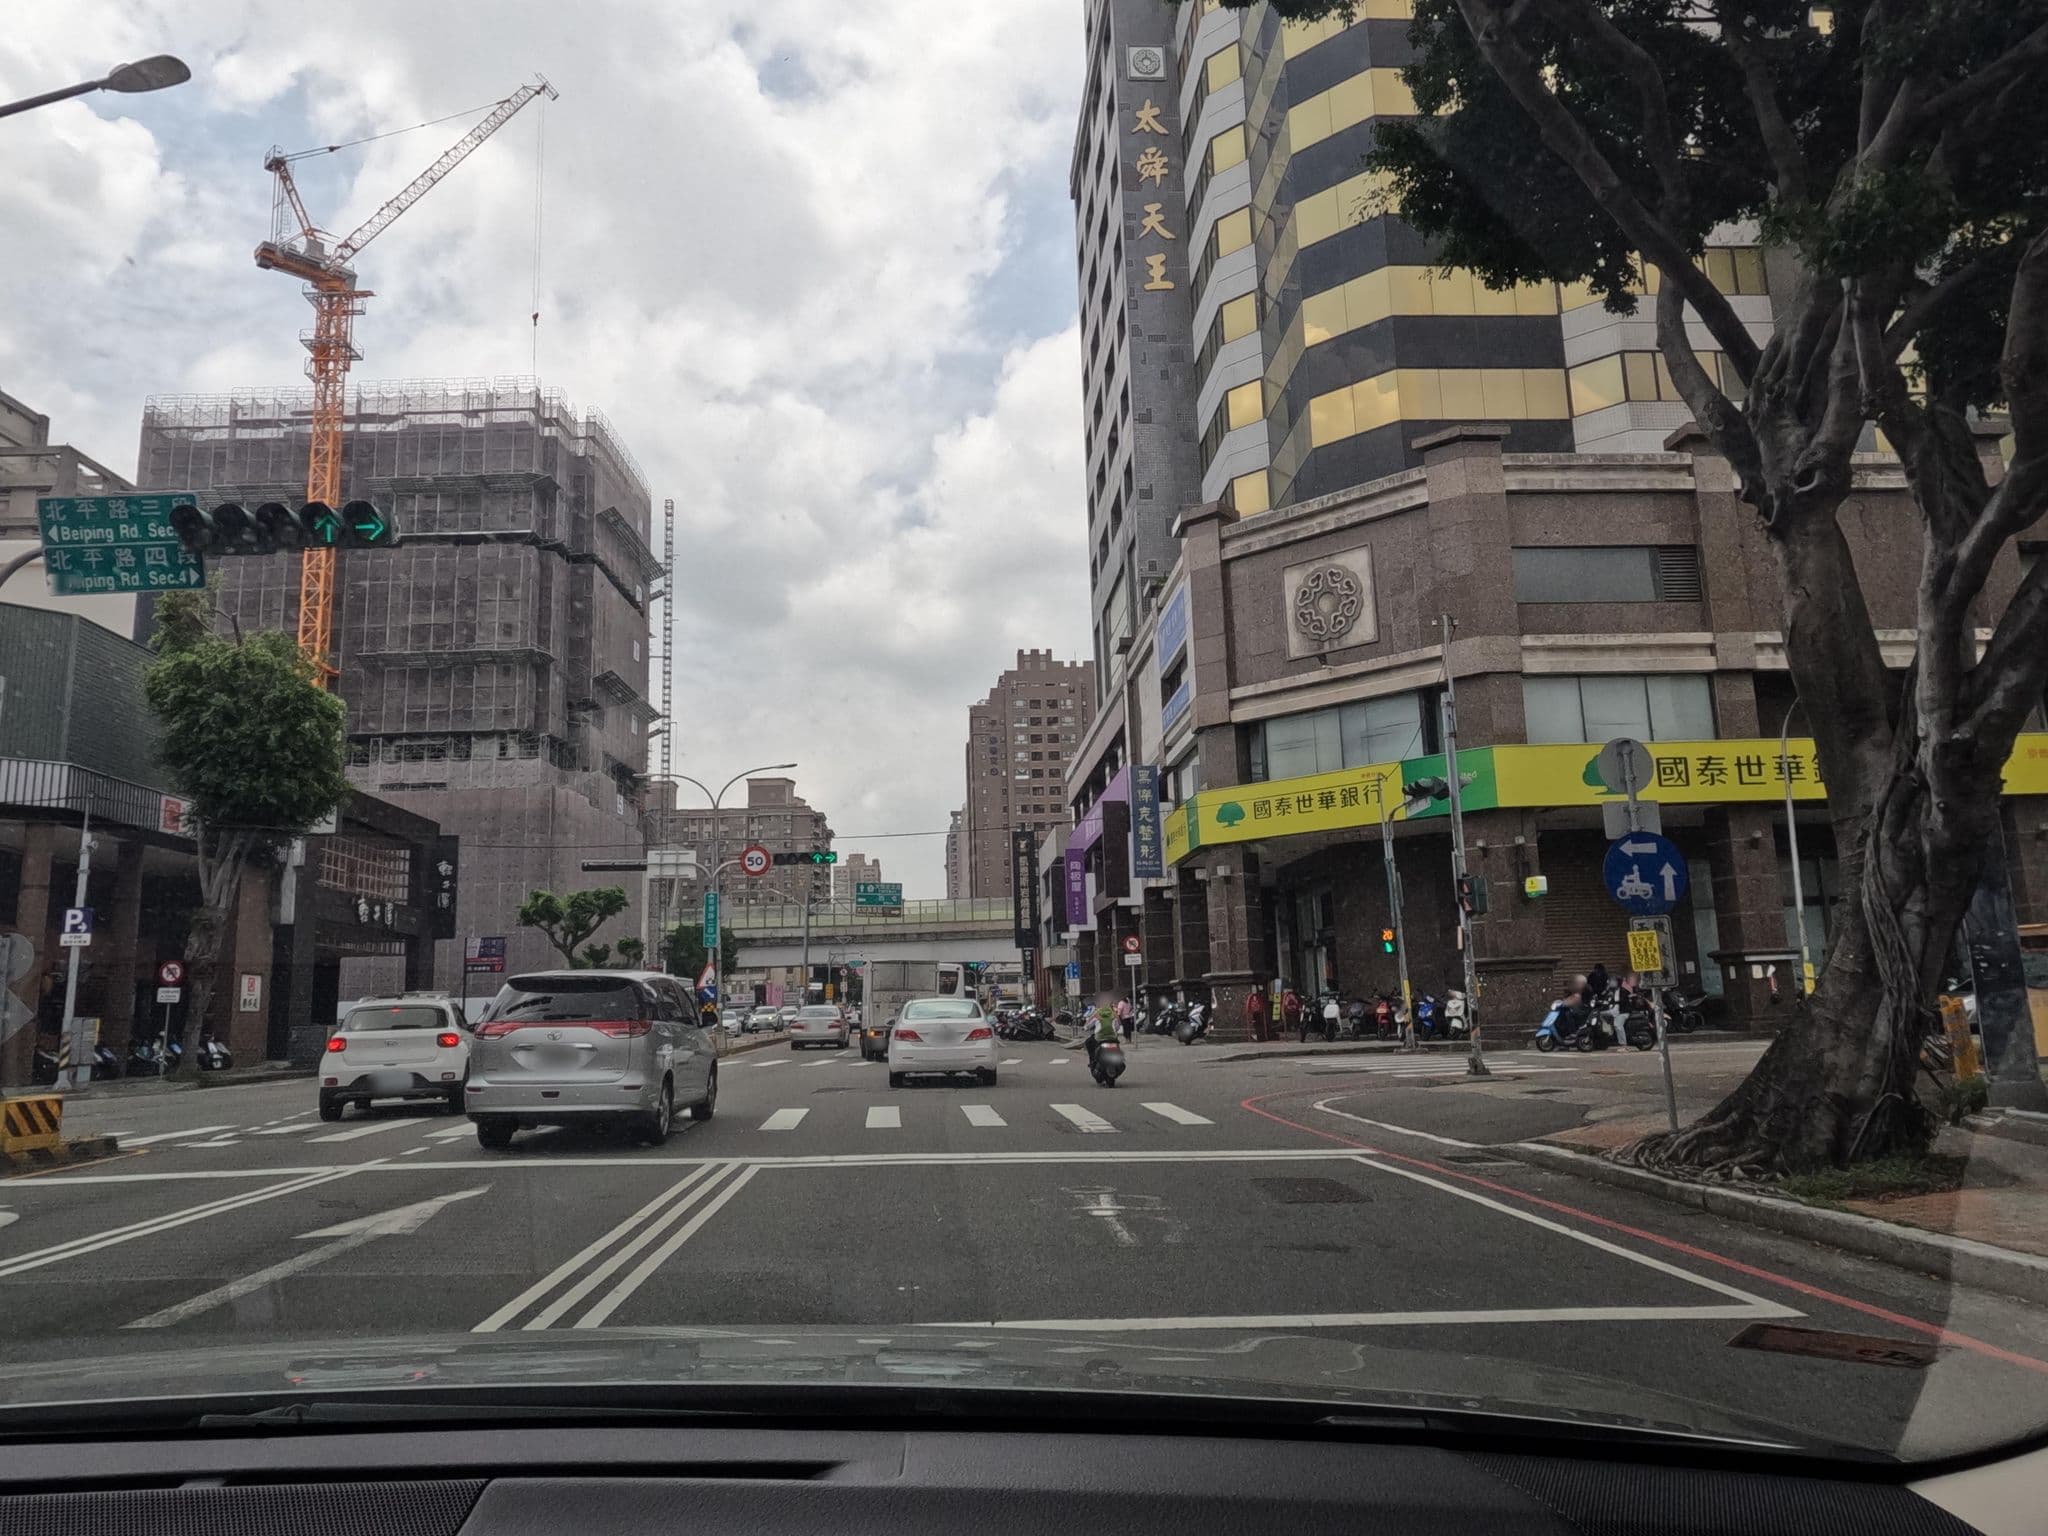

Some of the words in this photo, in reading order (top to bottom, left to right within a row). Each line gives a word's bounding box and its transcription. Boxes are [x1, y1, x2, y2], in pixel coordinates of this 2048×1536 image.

[1131, 98, 1177, 291] 太舜天王
[61, 525, 114, 543] Beiping
[119, 523, 142, 539] Rd.
[147, 521, 179, 538] Sec.
[120, 570, 143, 587] Rd.
[149, 569, 187, 586] Sec.4
[1254, 783, 1381, 820] 國泰世華銀行
[747, 856, 764, 867] 50
[64, 909, 84, 933] P
